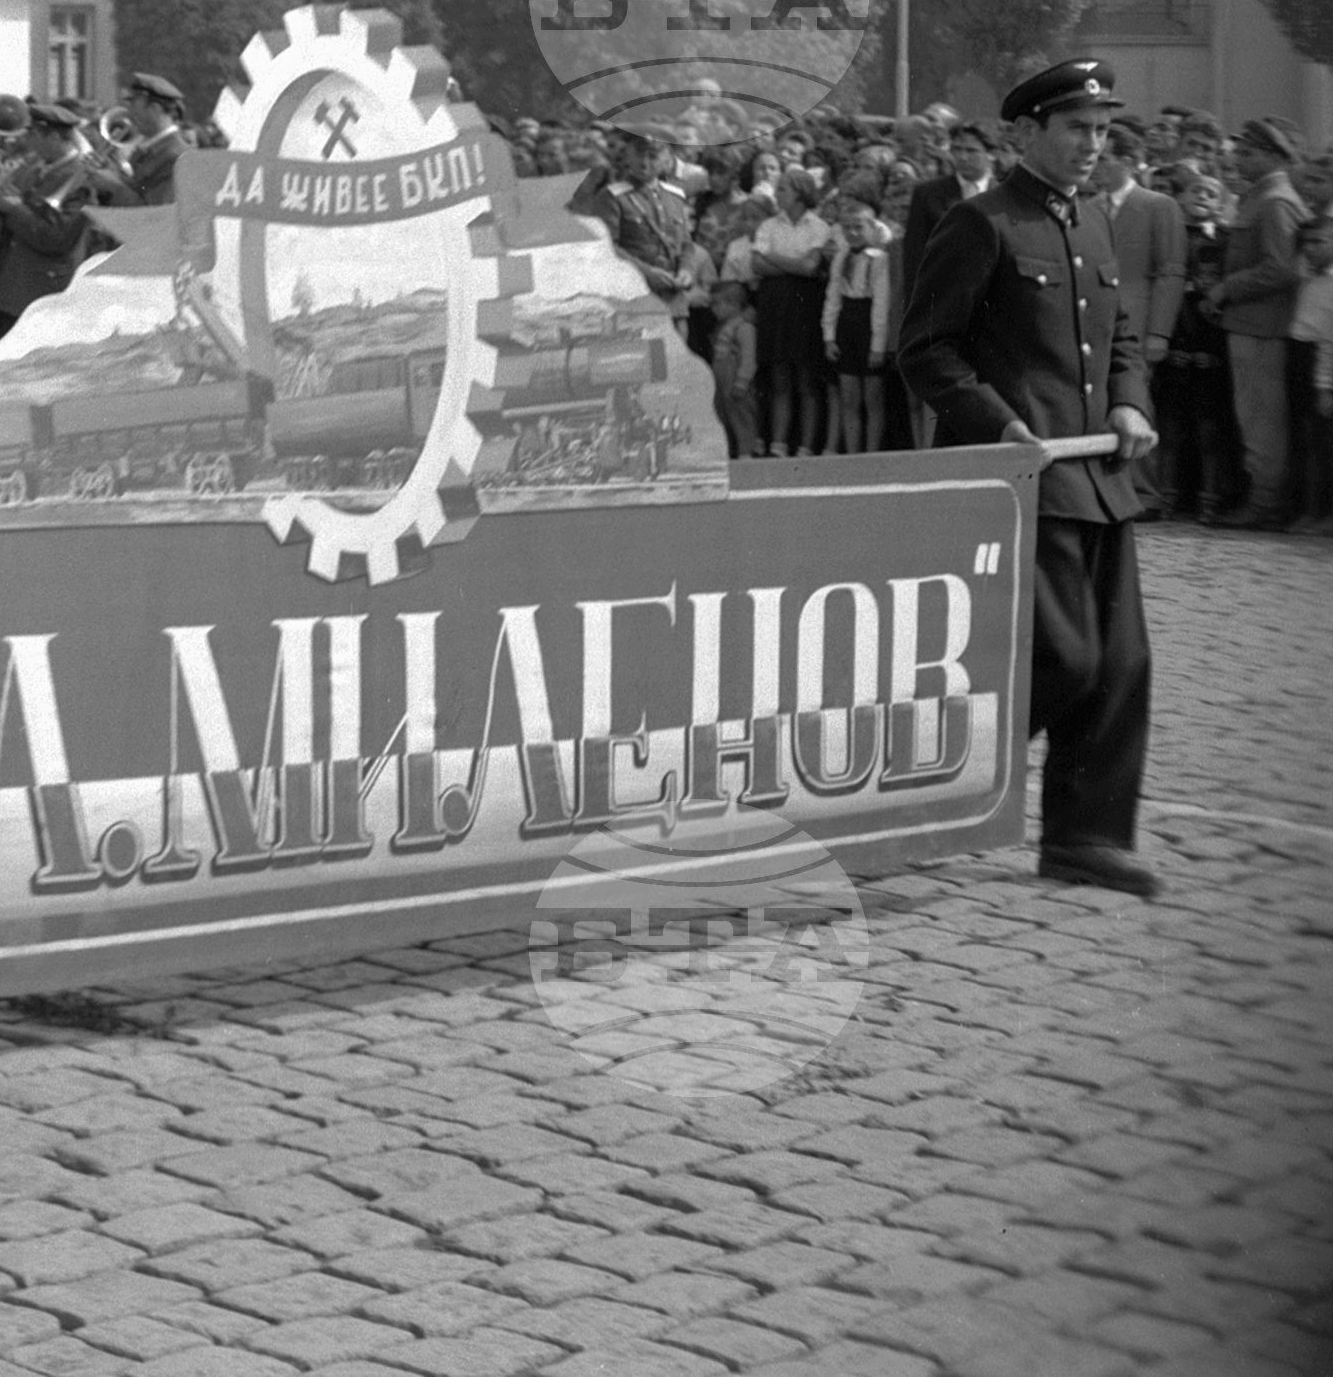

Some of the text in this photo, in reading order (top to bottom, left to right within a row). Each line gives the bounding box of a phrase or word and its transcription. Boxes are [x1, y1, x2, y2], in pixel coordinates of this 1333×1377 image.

[215, 142, 486, 215] ДА ЖИВЕЕ БКП!
